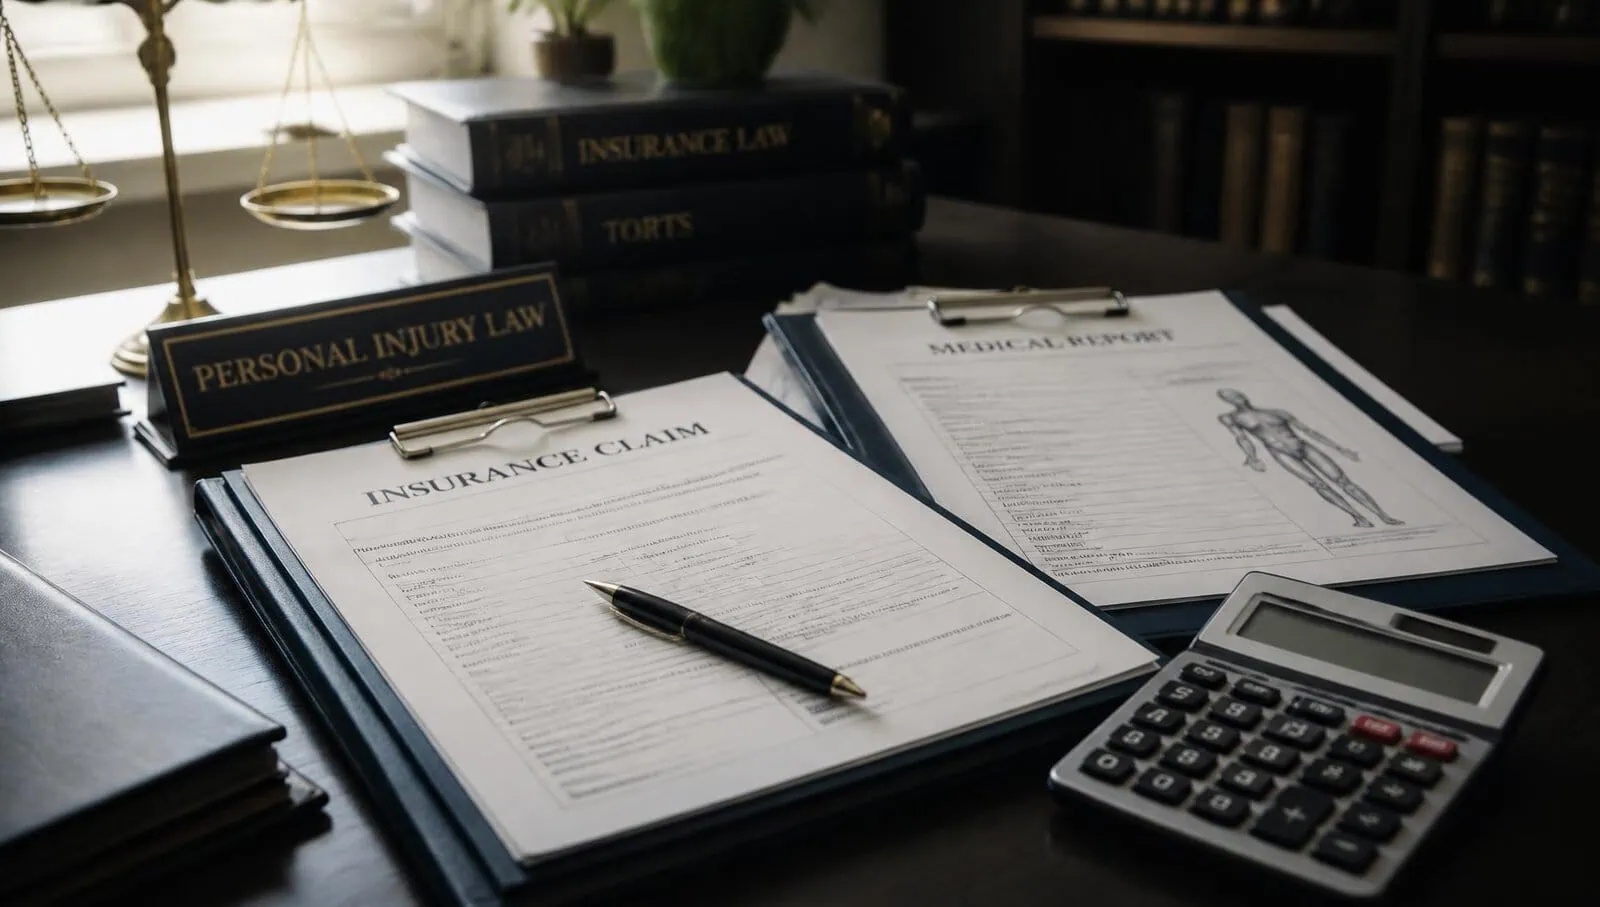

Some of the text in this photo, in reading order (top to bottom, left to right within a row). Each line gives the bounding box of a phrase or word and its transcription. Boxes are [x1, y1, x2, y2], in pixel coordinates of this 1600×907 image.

[577, 127, 729, 165] INSURANCE
[735, 123, 792, 152] LAW
[604, 212, 694, 244] TORTS
[193, 303, 547, 392] PERSONAL INJURY LAW
[928, 328, 1174, 356] MEDICAL REPORT
[365, 448, 587, 506] INSURANCE
[594, 421, 710, 456] CLAIM
